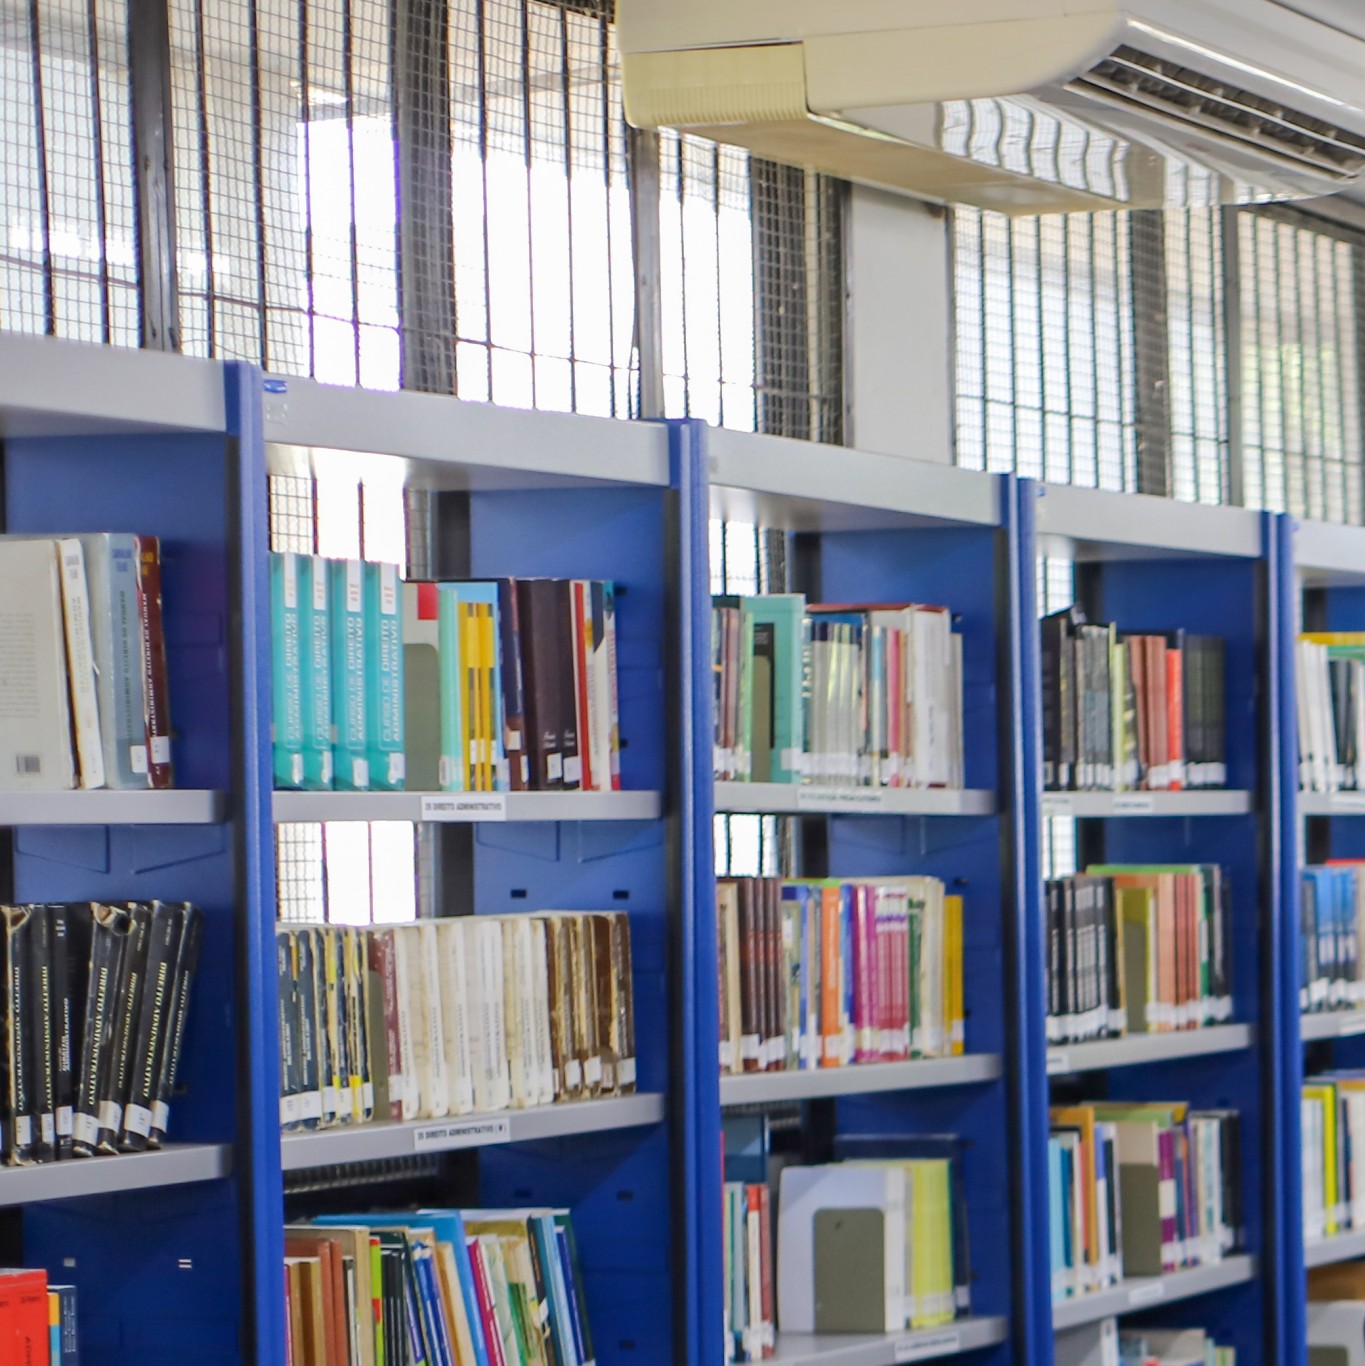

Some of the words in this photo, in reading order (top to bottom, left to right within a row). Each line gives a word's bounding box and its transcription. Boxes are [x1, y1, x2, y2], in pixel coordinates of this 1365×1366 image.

[284, 613, 292, 665] DIREITO
[313, 615, 321, 668] DIREITO
[347, 617, 355, 669] DIREITO
[381, 620, 390, 671] DIREITO
[286, 672, 293, 688] DE
[292, 613, 300, 739] ADMINISTRATIVO
[314, 673, 322, 689] DE
[321, 616, 329, 739] ADMINISTRATIVO
[347, 673, 355, 690] DE
[356, 618, 364, 740] ADMINISTRATIVO
[381, 674, 390, 692] DE
[390, 620, 400, 742] ADMINISTRATIVO
[286, 695, 294, 739] CURSO
[315, 693, 324, 740] CURSO
[347, 695, 356, 740] CURSO
[381, 696, 391, 742] CURSO
[41, 965, 49, 1012] DIREITO
[96, 966, 108, 1012] DIREITO
[126, 972, 137, 1010] DIREITO
[155, 961, 167, 1006] DIREITO
[180, 970, 190, 1008] DIREITO
[15, 1014, 24, 1112] ADMINISTRATIVO
[43, 1014, 52, 1110] ADMINISTRATIVO
[88, 1014, 103, 1105] ADMINISTRATIVO
[118, 1010, 133, 1089] ADMINISTRATIVO
[142, 1007, 159, 1098] ADMINISTRATIVO
[169, 1009, 184, 1085] ADMINISTRATIVO
[449, 1125, 493, 1136] ADMINISTRATIVO
